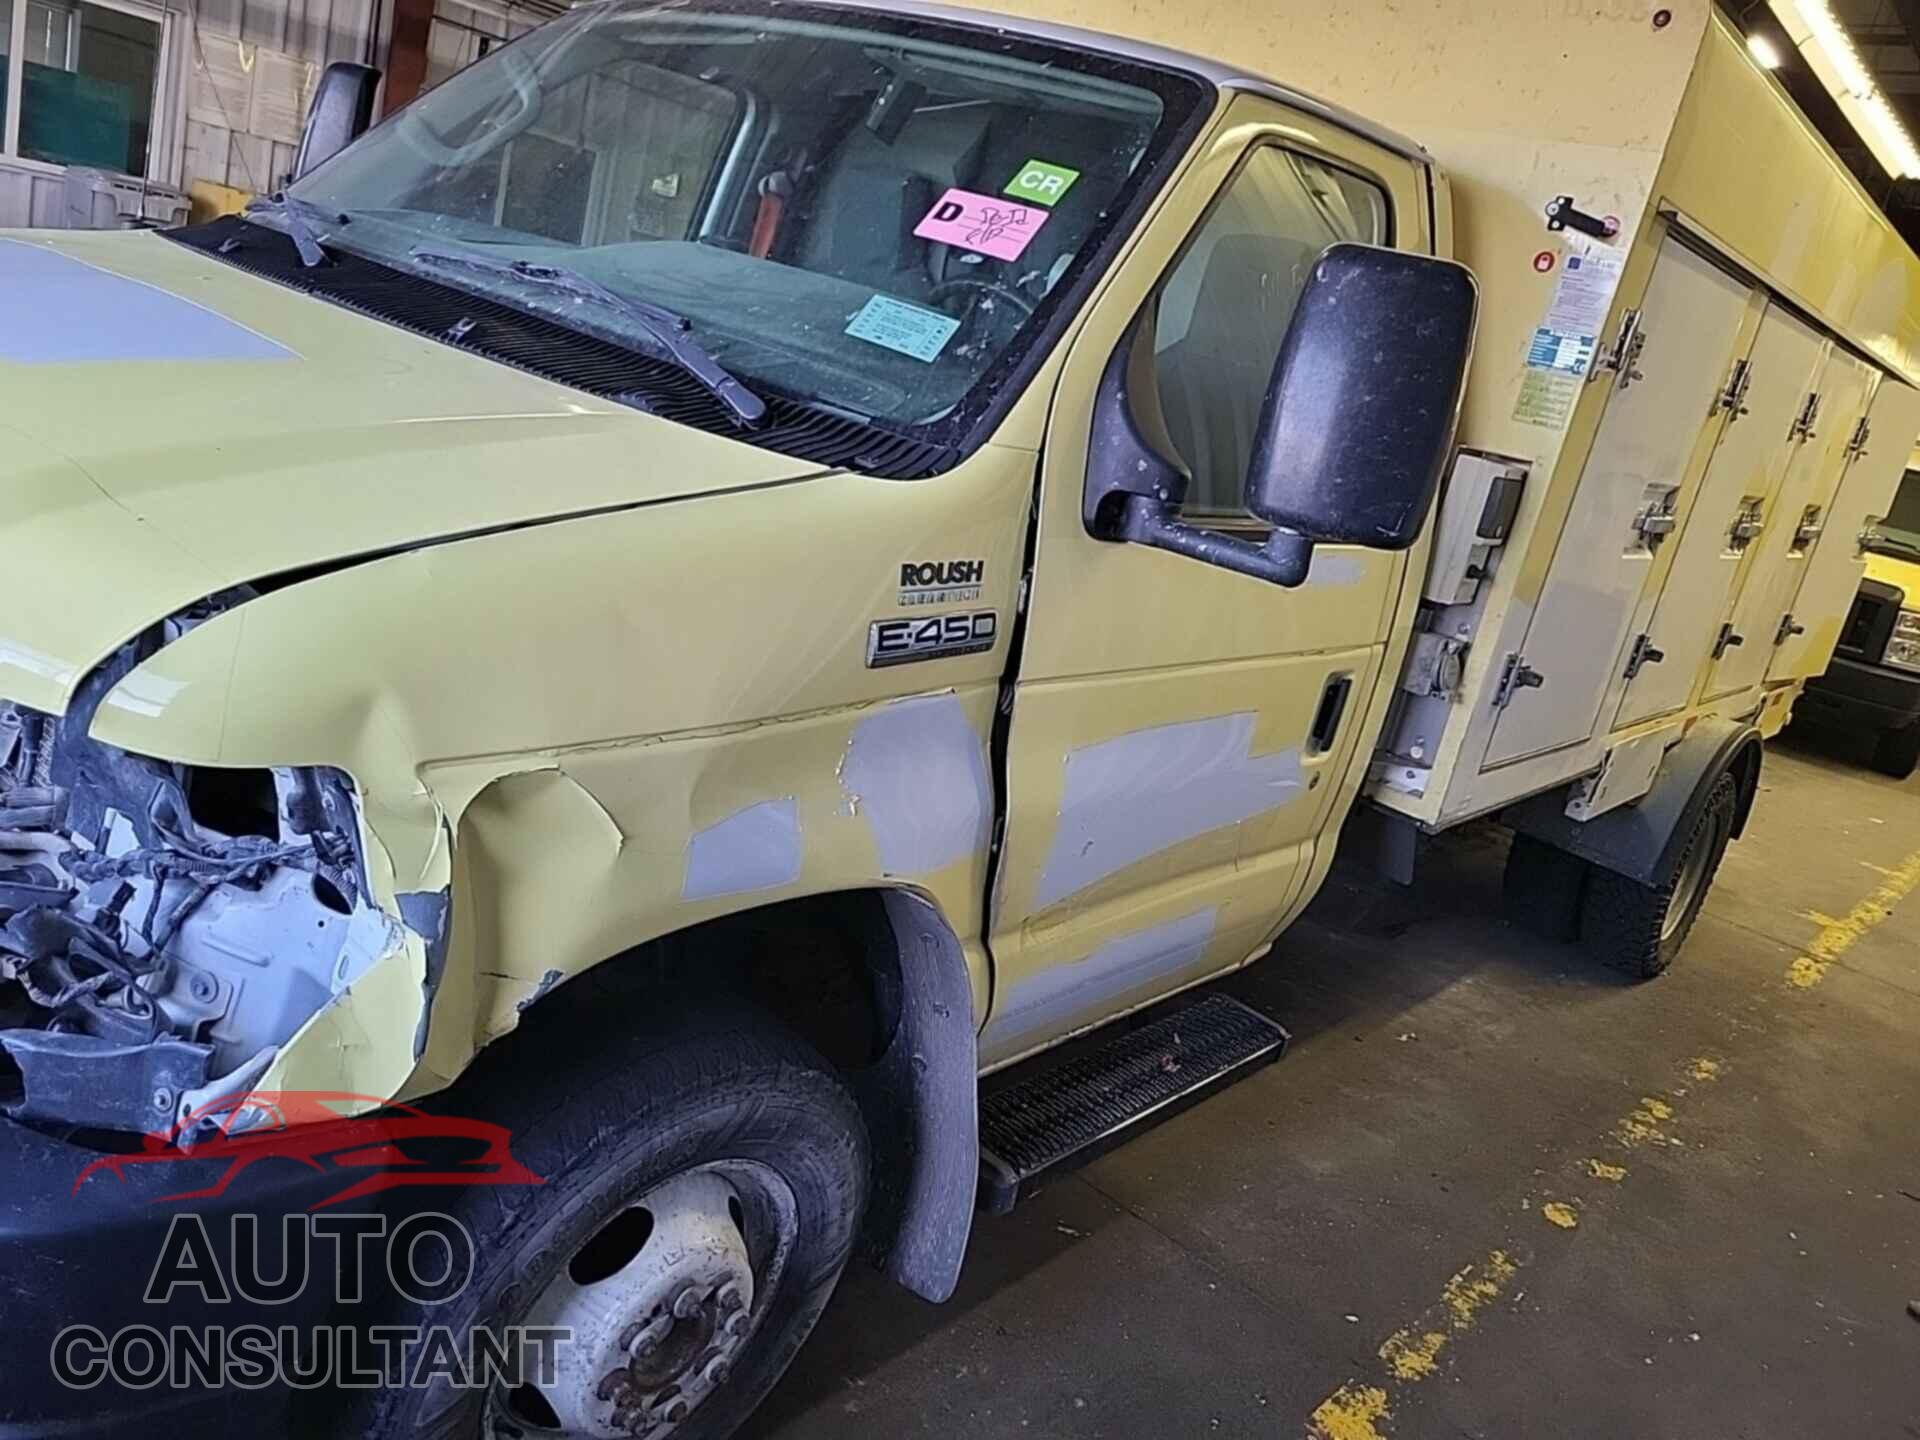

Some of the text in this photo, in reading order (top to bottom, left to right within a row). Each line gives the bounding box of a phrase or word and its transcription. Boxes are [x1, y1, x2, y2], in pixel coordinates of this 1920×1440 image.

[1021, 170, 1064, 194] CR
[934, 202, 963, 222] D
[901, 560, 984, 586] ROUSH
[877, 612, 996, 652] E-450
